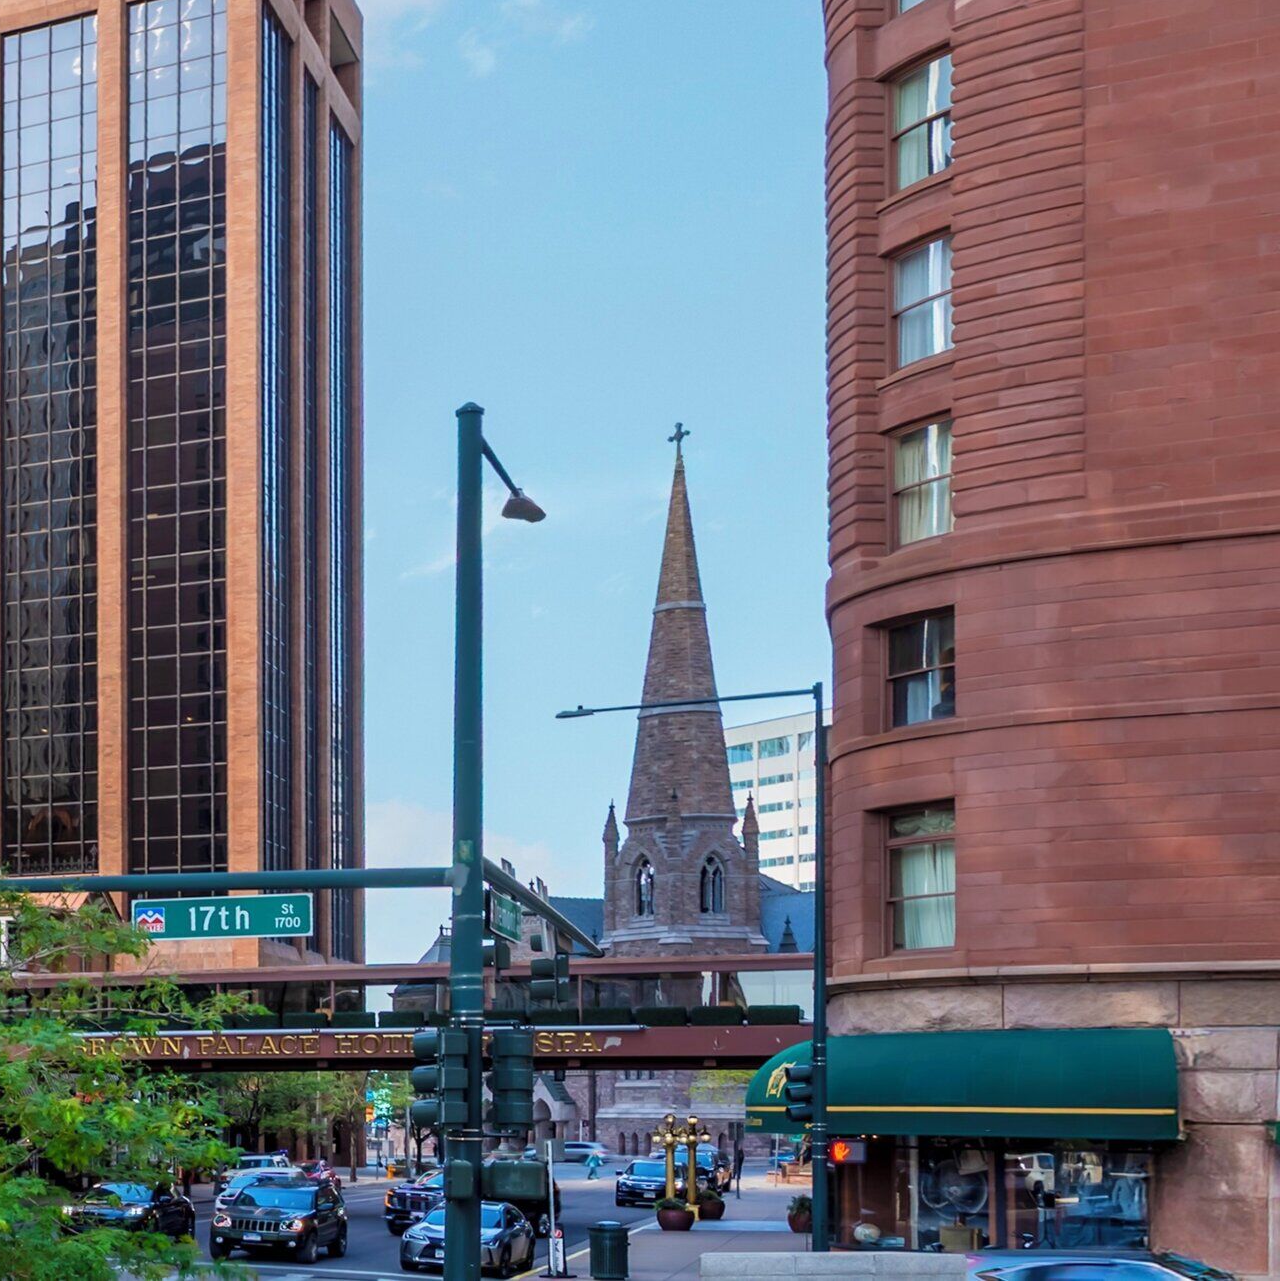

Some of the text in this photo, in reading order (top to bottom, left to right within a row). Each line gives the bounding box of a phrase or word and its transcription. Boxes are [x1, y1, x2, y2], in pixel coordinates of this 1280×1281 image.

[188, 903, 295, 931] 17th St
[274, 917, 302, 929] 1700
[196, 1035, 320, 1055] PALACE
[334, 1034, 415, 1054] HOT
[536, 1032, 602, 1053] SPA
